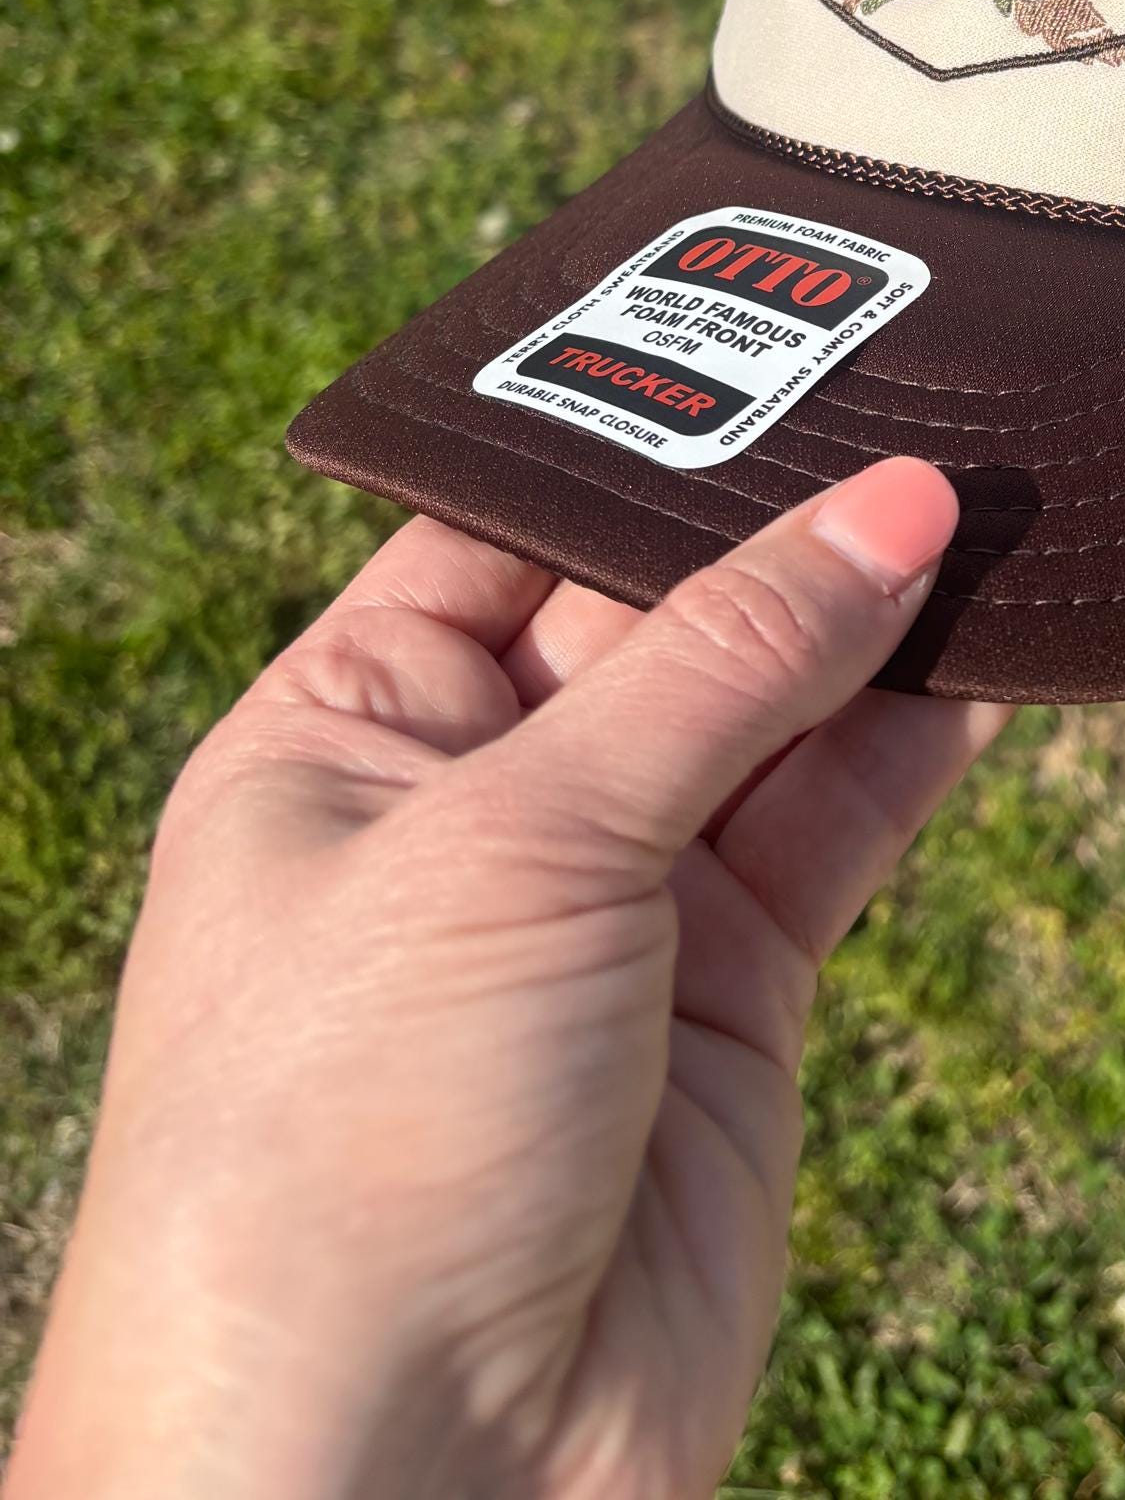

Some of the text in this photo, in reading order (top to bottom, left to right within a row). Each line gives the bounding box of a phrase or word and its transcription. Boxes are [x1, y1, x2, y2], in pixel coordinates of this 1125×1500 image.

[731, 213, 891, 262] PREMIUM FOAM FABRIC
[501, 229, 685, 364] TERRY CLOTH SWEATBAND
[626, 285, 807, 349] WORLD FAMOUS
[620, 304, 772, 358] FOAM FRONT
[642, 331, 704, 355] OSFM
[720, 281, 914, 446] SOFT & COMFY SWEATBAND
[497, 381, 668, 449] DURABLE SNAP CLOSURE
[549, 347, 717, 417] TRUCKER
